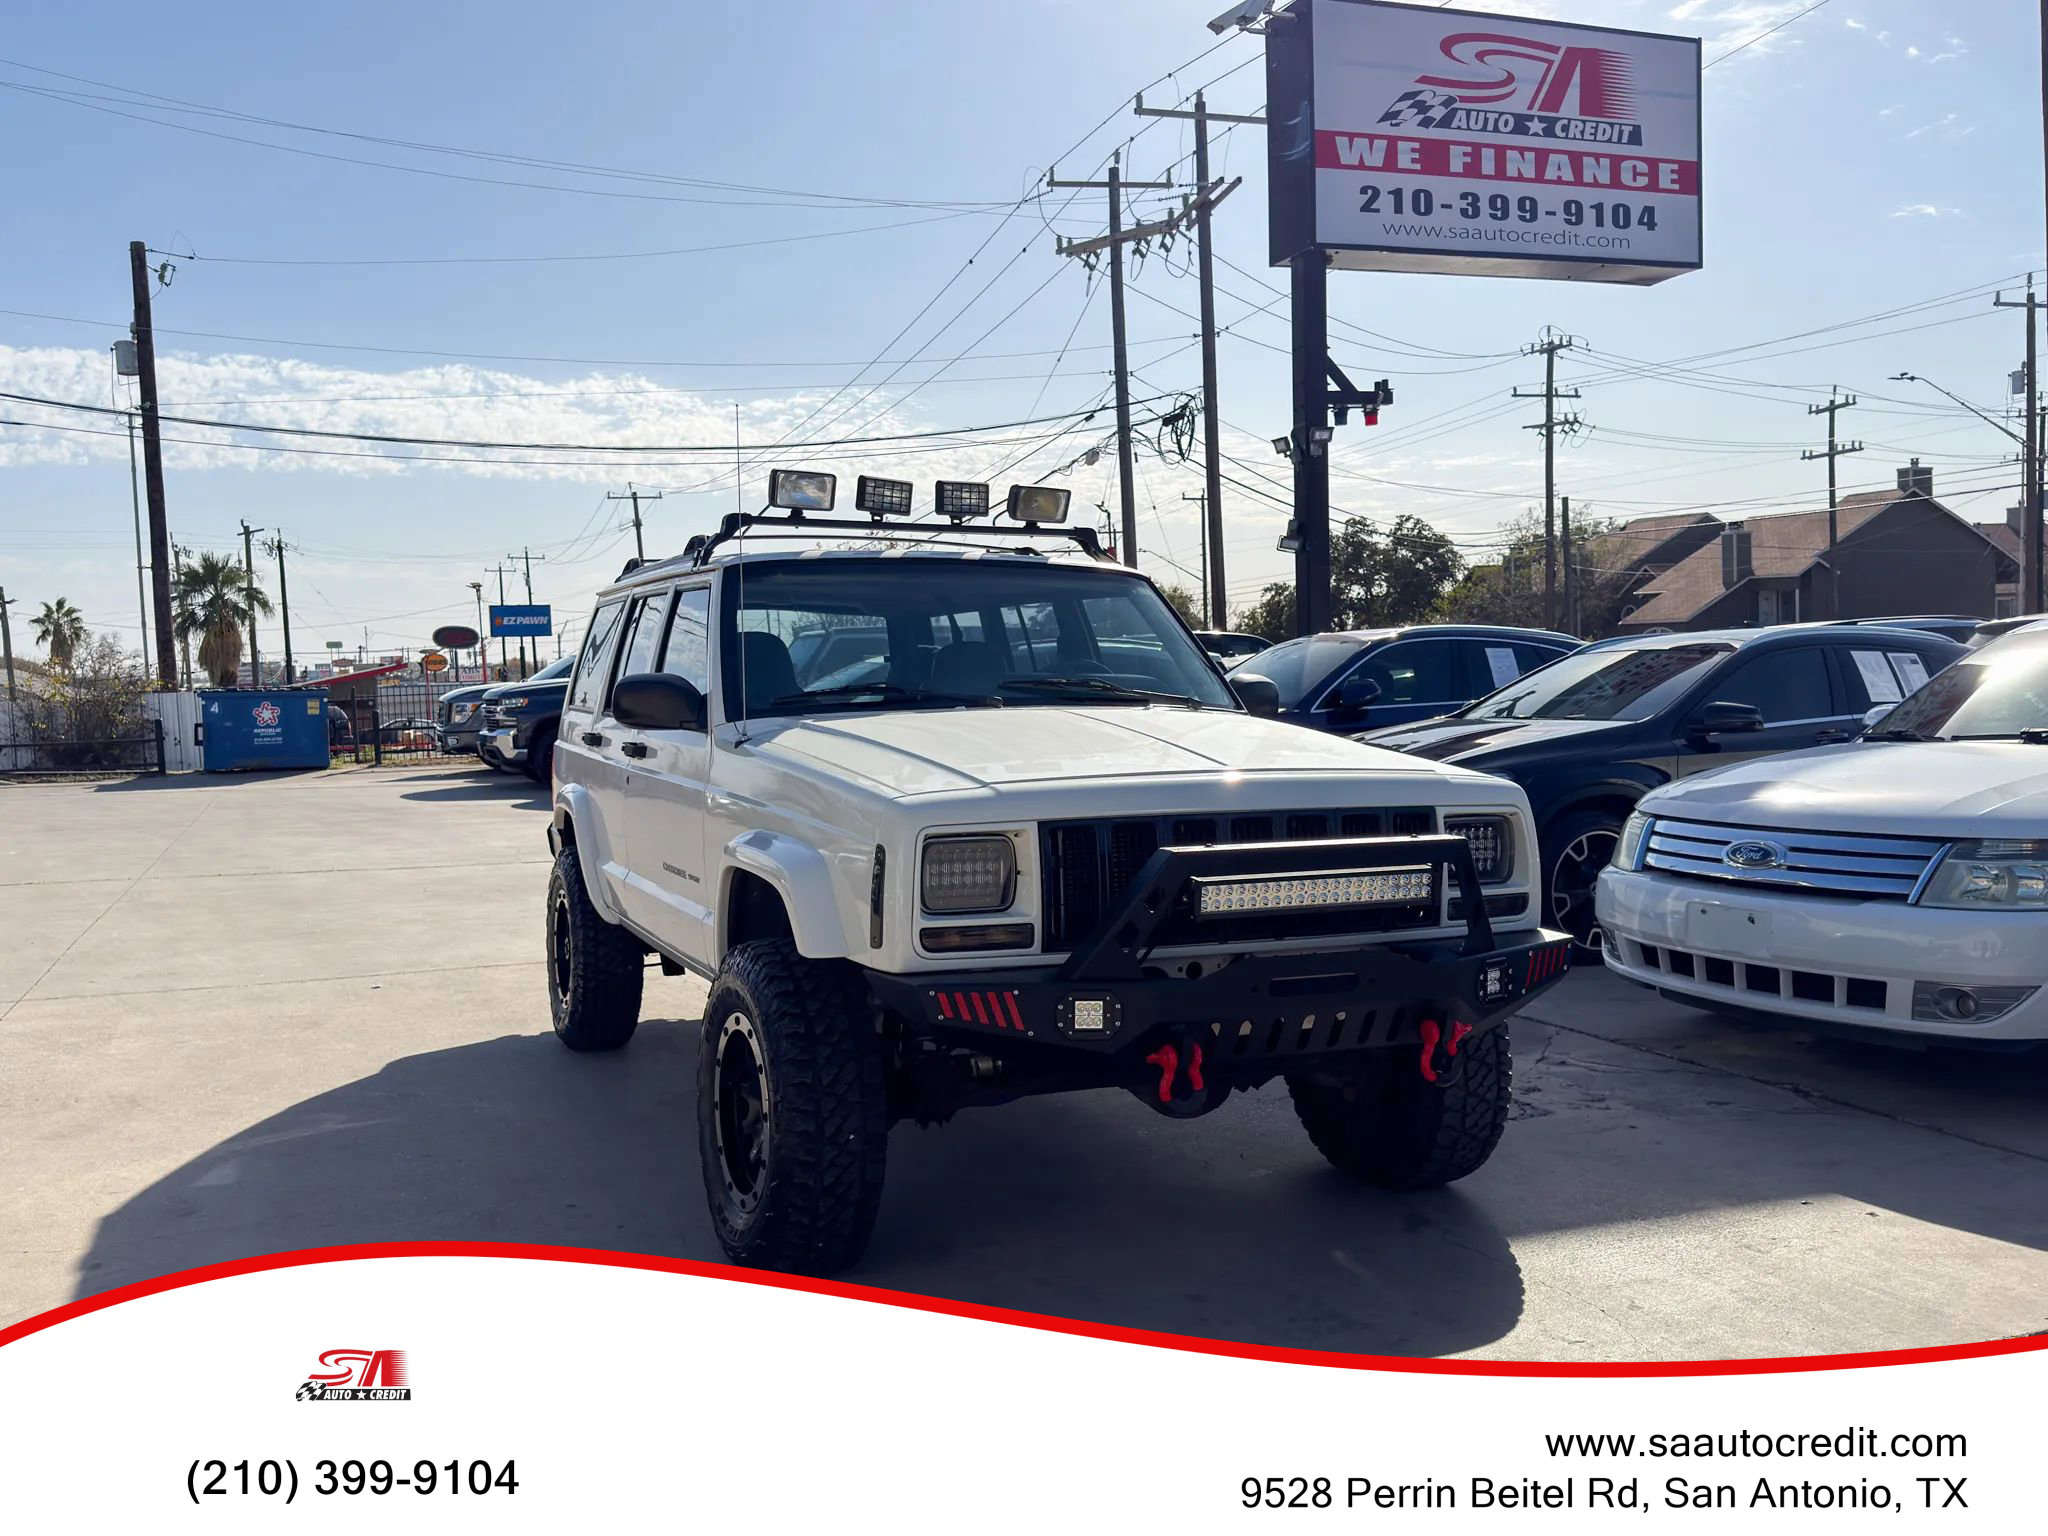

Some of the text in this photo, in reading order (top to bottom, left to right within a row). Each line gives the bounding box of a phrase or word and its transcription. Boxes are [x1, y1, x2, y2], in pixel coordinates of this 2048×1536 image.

[1413, 33, 1638, 120] SA
[1451, 108, 1633, 144] AUTO CREDIT
[1335, 136, 1681, 191] WE FINANCE
[1359, 185, 1658, 232] 210-399-9104
[1383, 222, 1631, 249] www.saautocredit.com
[210, 702, 219, 714] 4
[1736, 846, 1764, 859] Ford
